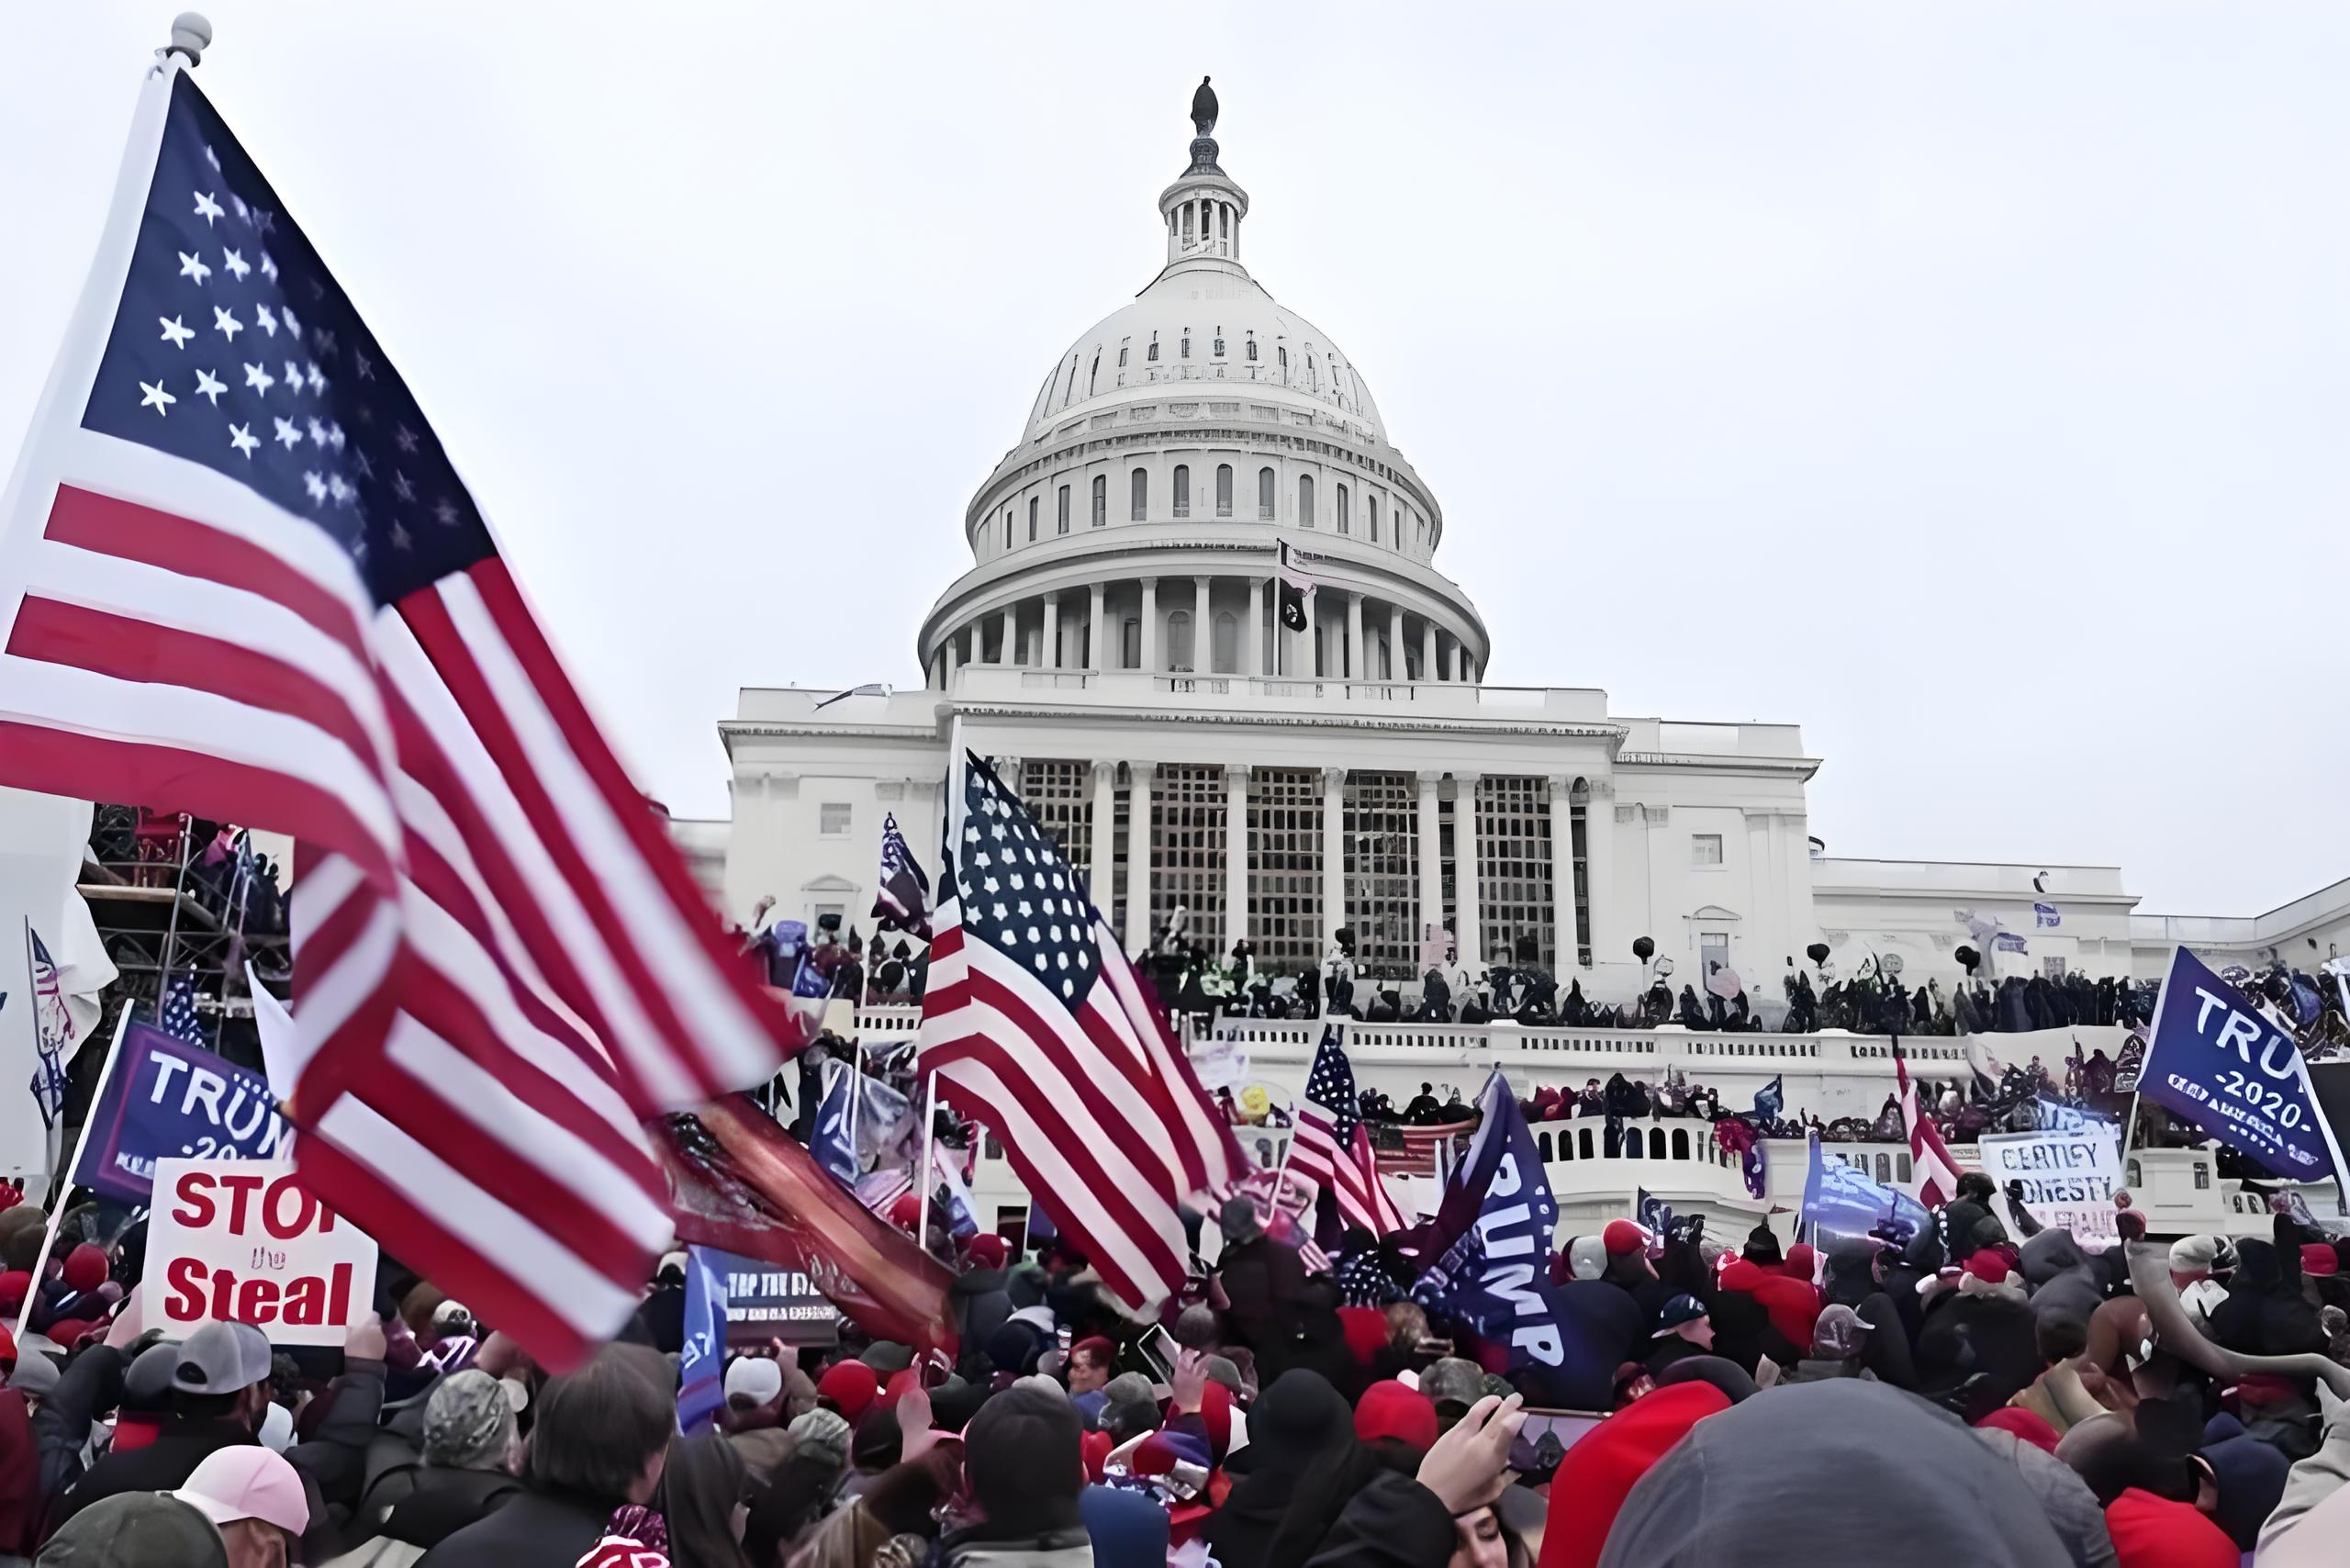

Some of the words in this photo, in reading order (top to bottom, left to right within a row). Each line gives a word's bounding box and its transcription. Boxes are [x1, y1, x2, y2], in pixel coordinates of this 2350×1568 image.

[2195, 985, 2300, 1081] TRU
[163, 1256, 353, 1326] Steal
[1475, 1151, 1565, 1367] RUMP
